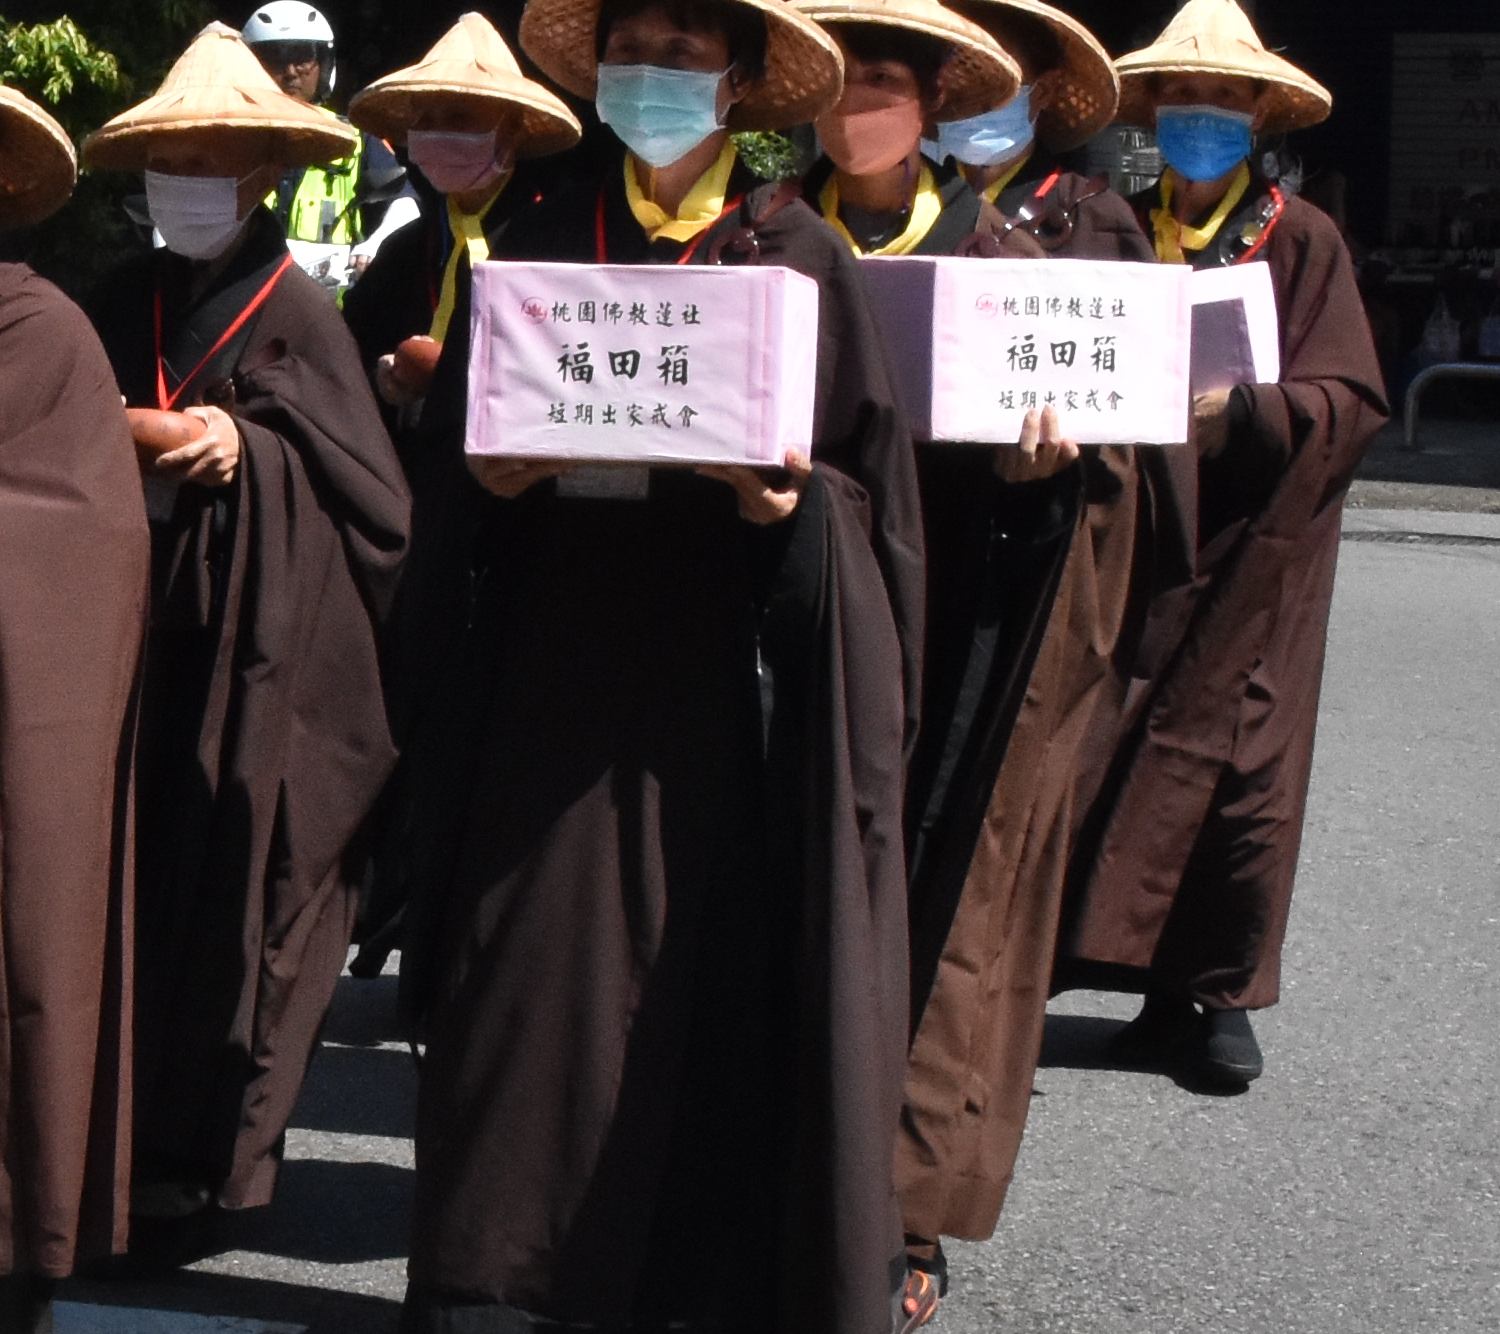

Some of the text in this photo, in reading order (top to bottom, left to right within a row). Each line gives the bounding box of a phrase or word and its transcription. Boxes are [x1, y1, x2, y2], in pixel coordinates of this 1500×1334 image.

[551, 300, 701, 327] 桃園佛教蓮社
[1003, 296, 1126, 319] 桃園佛教蓮社
[557, 342, 689, 385] 福田箱
[1007, 334, 1116, 372] 福田箱
[547, 402, 698, 427] 短期出家戒會
